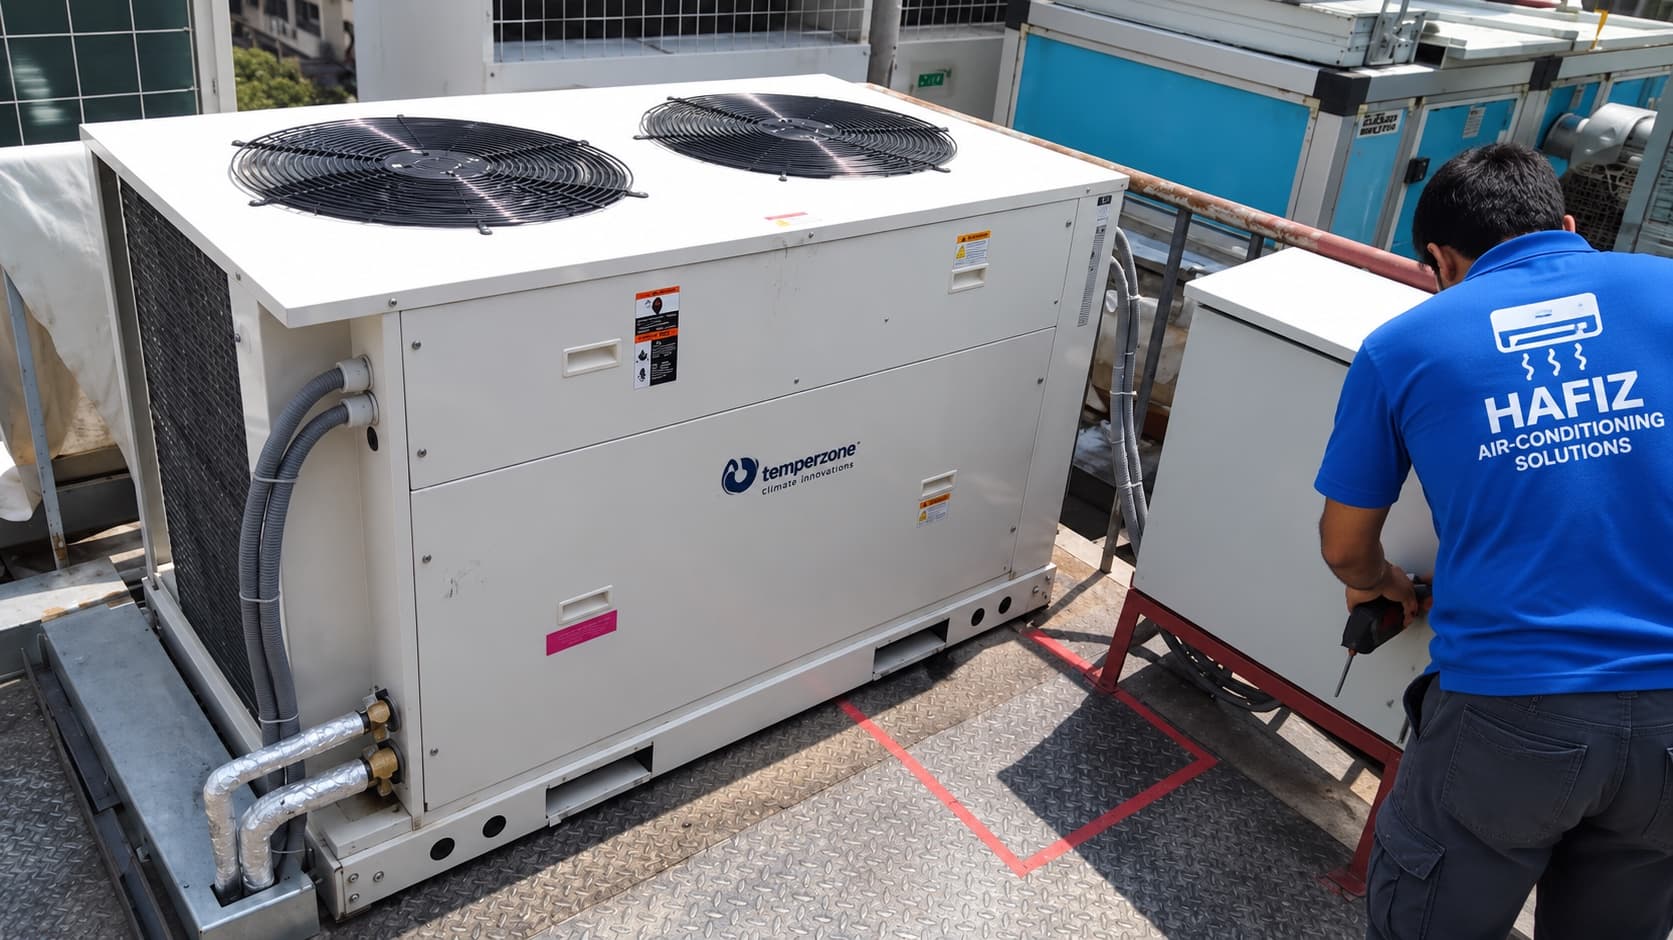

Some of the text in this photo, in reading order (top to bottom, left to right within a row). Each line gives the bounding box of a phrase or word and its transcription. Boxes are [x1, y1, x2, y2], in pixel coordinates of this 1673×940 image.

[1484, 370, 1644, 434] HAFIZ
[1478, 412, 1665, 460] AIR-CONDITIONING
[1515, 437, 1632, 471] SOLUTIONS
[761, 462, 854, 495] climate innovations
[762, 443, 857, 482] temperzone
